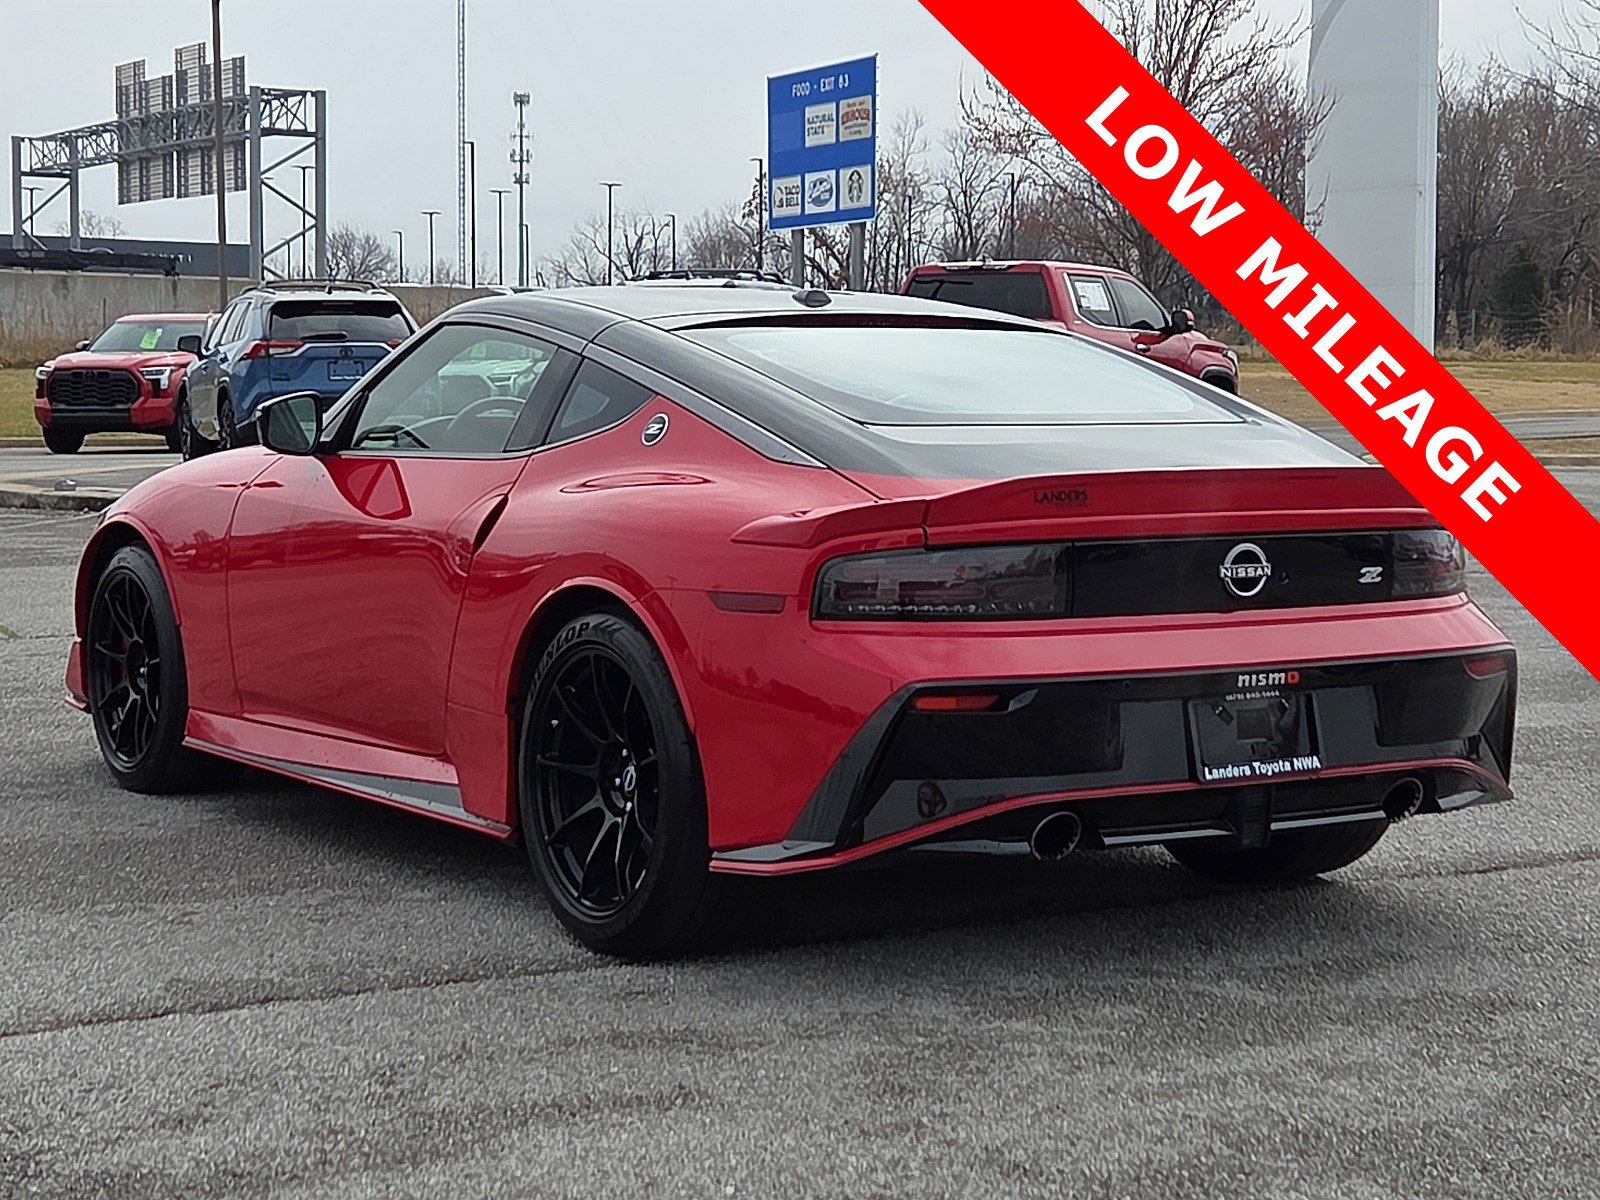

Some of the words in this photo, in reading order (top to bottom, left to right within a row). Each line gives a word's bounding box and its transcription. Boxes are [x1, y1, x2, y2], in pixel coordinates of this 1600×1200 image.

[792, 82, 810, 97] FOOD
[820, 76, 835, 92] EXIT
[807, 113, 835, 125] NATURAL
[807, 125, 825, 137] STATE
[784, 185, 800, 195] TACO
[785, 195, 800, 208] BELL
[1033, 489, 1088, 504] LANDERS
[1219, 565, 1271, 578] NISSAN
[1358, 566, 1383, 583] Z
[1204, 764, 1251, 780] Landers
[1252, 760, 1292, 777] Toyota
[1293, 755, 1321, 771] NWA
